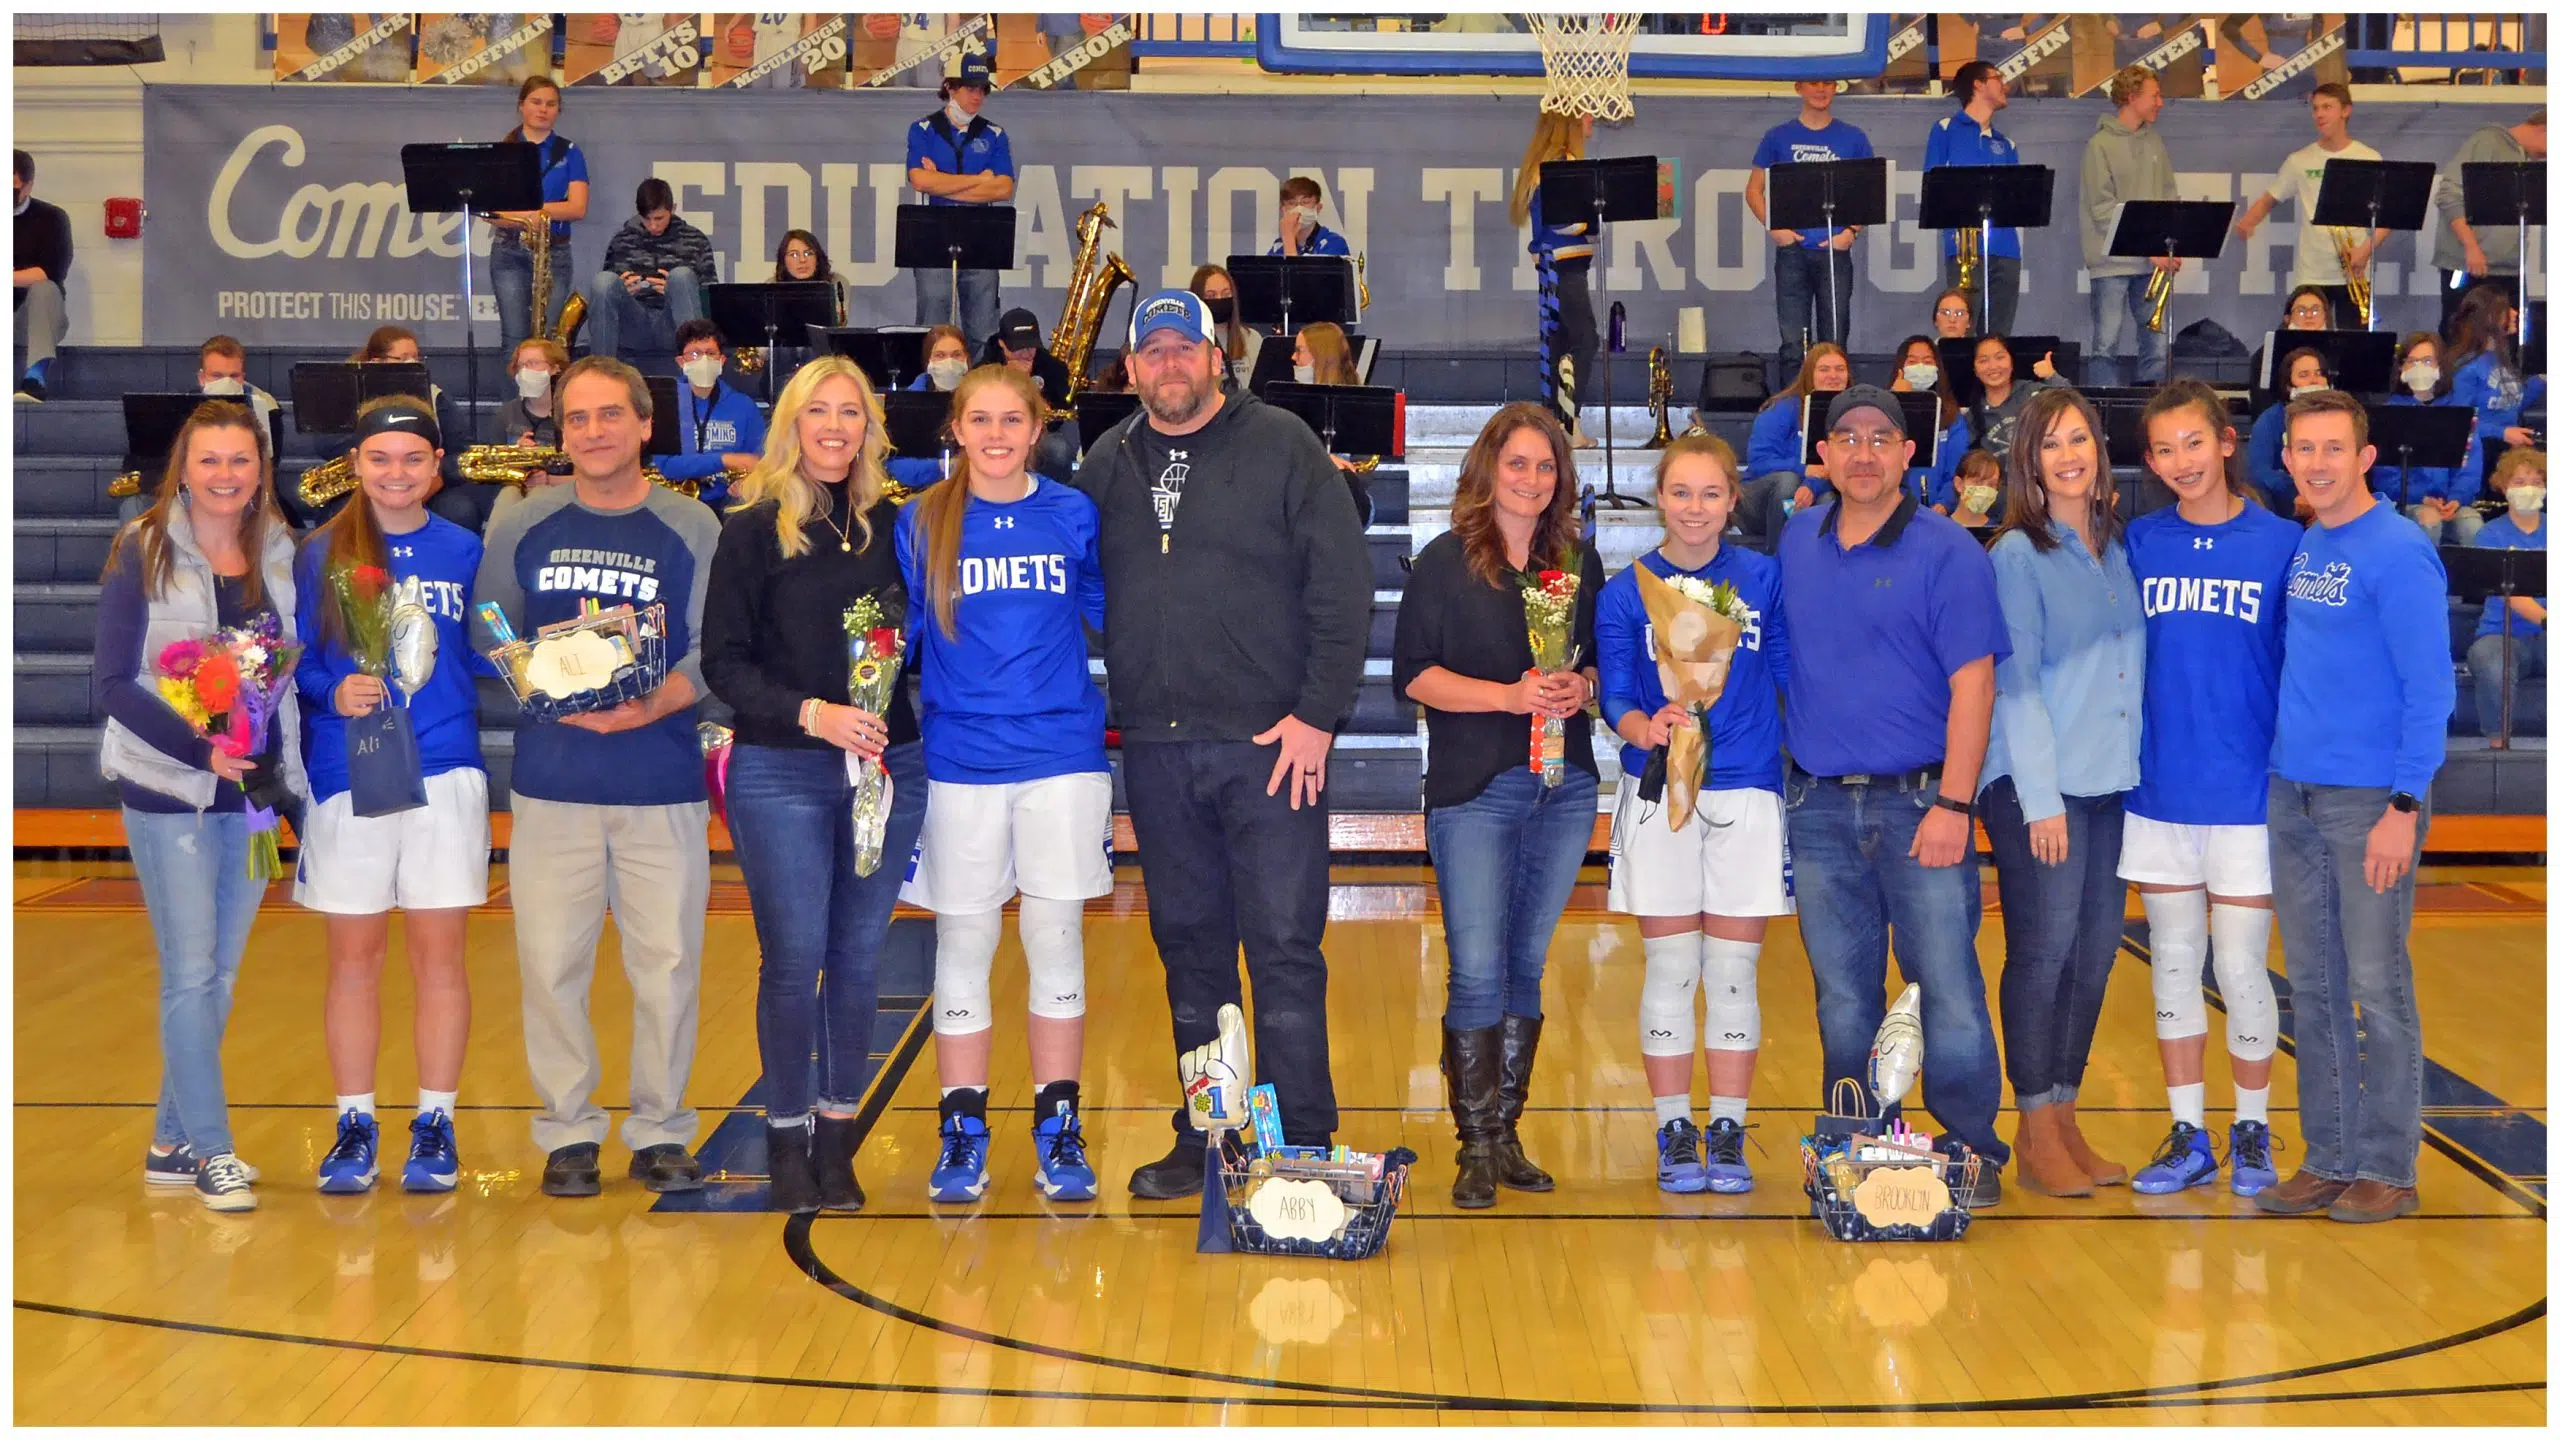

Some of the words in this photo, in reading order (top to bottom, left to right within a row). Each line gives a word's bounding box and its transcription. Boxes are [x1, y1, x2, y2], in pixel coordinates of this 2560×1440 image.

[302, 13, 410, 82] BORWICK
[442, 14, 553, 85] HOFFMAN
[600, 20, 698, 85] BETTS
[659, 45, 699, 77] 10
[733, 17, 847, 89] McCULLOUGH
[801, 36, 847, 75] 20
[1028, 23, 1132, 89] TABOR
[2243, 33, 2345, 100] CANTRILL
[208, 124, 497, 260] Come
[652, 161, 1374, 291] EDUATION
[218, 291, 323, 319] PROTECT
[329, 293, 370, 320] THIS
[1142, 302, 1191, 327] COMETS
[550, 548, 657, 573] GREENVILLE
[957, 554, 1066, 595] OMETS
[538, 566, 659, 602] COMETS
[2143, 577, 2263, 624] COMETS
[559, 653, 587, 678] ALI
[357, 736, 380, 756] Ali
[1194, 1086, 1227, 1119] #1
[1279, 1196, 1316, 1223] ABBY
